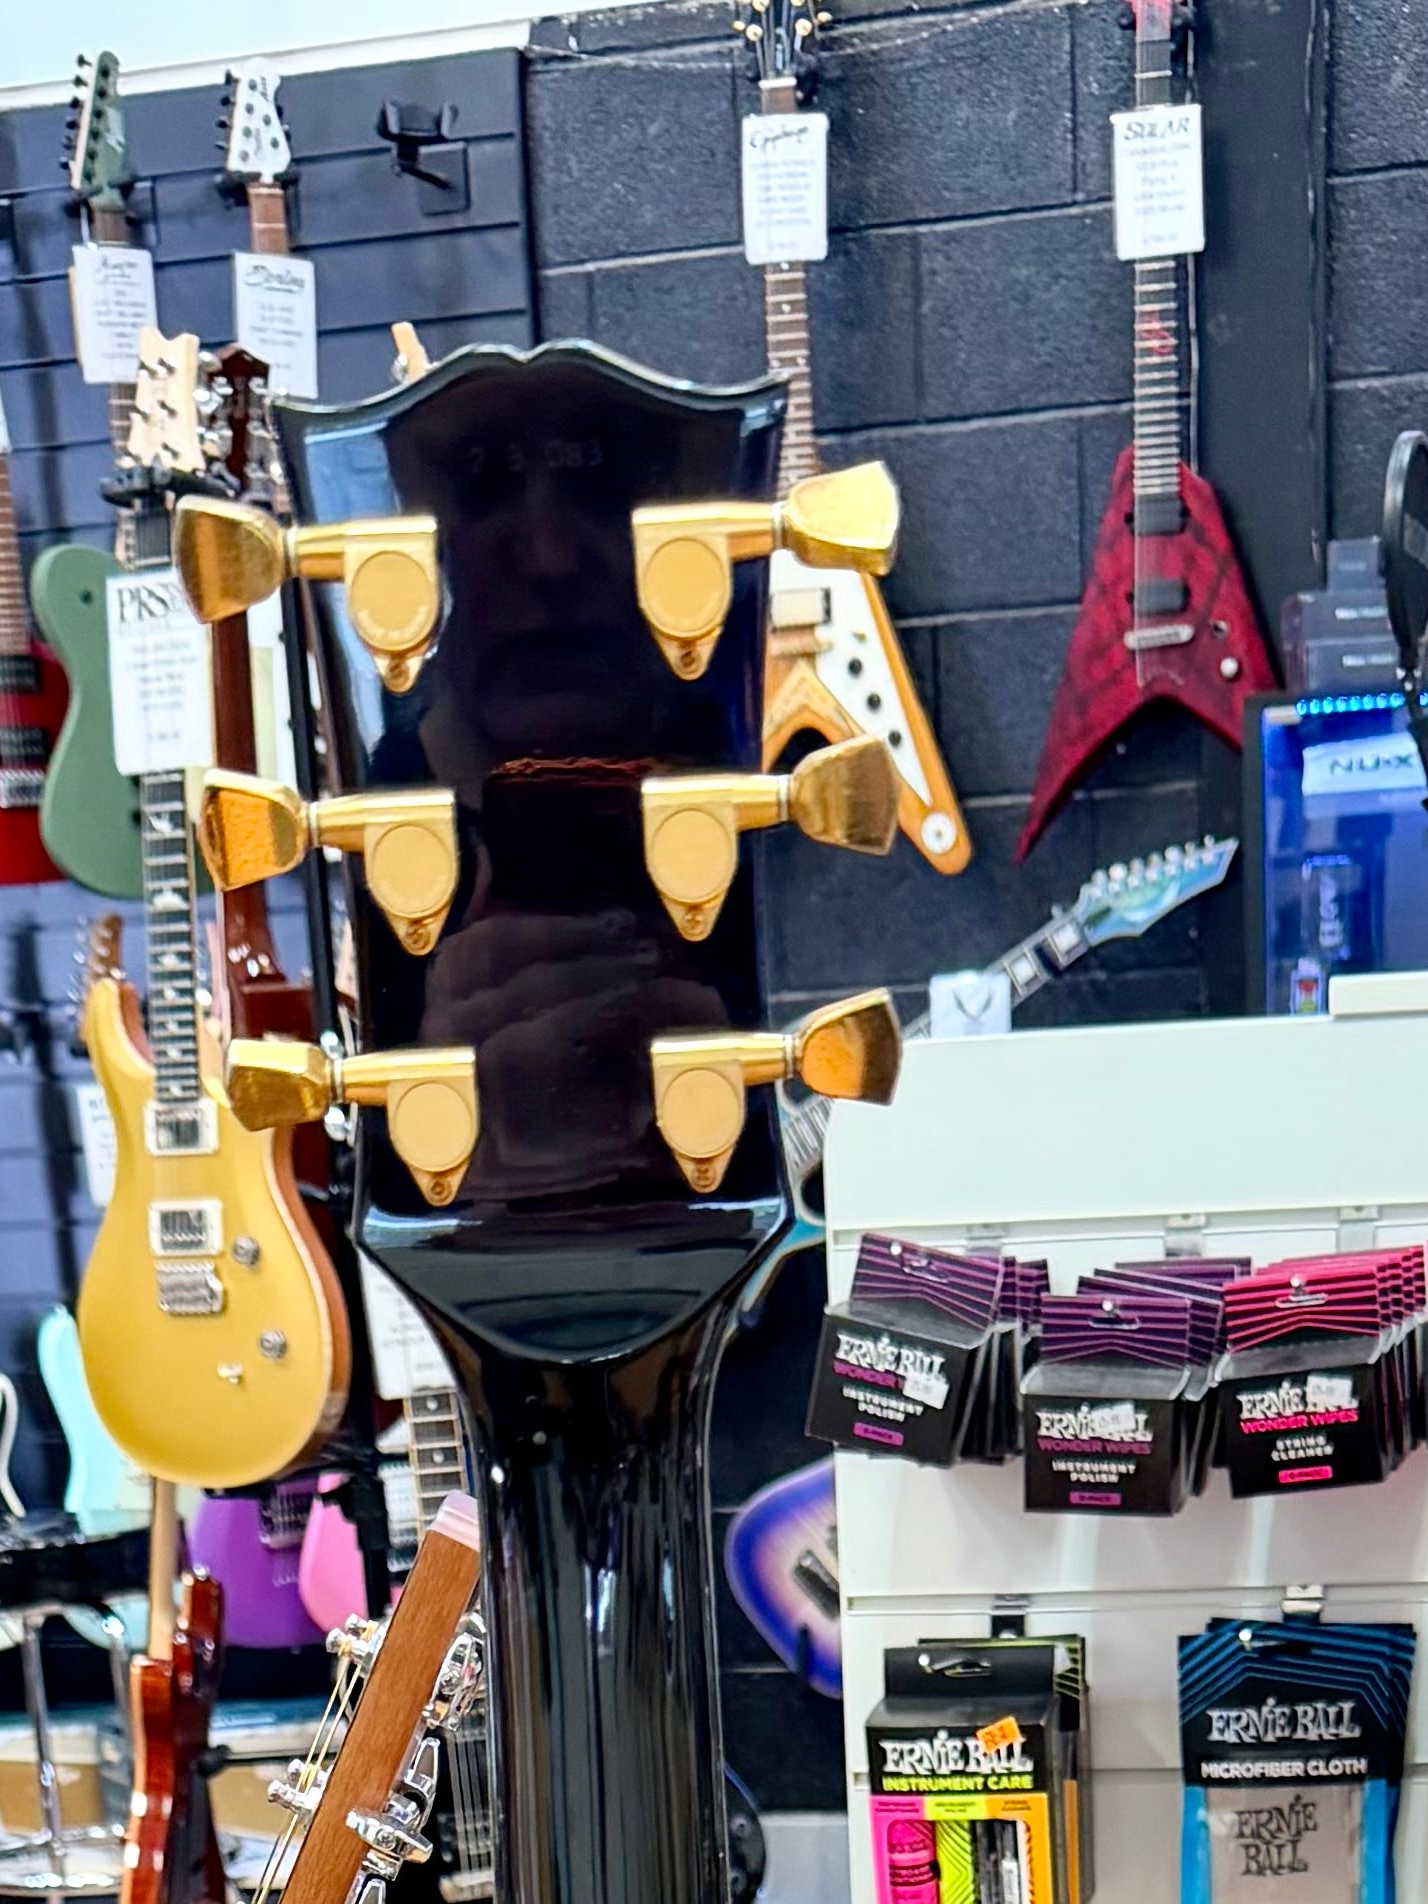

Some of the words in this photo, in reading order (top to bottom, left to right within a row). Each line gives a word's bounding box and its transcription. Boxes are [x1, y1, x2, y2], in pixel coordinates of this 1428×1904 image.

[1240, 1416, 1309, 1435] WONDER
[1310, 1410, 1359, 1426] WIPES
[1037, 1438, 1103, 1454] WONDER
[1294, 1701, 1363, 1743] BALL
[965, 1735, 1034, 1774] BALL
[1201, 1758, 1303, 1780] MICROFIBER
[1304, 1756, 1368, 1777] CLOTH
[882, 1775, 984, 1792] INSTRUMENT
[987, 1774, 1035, 1790] CARE
[1241, 1838, 1310, 1878] BALL
